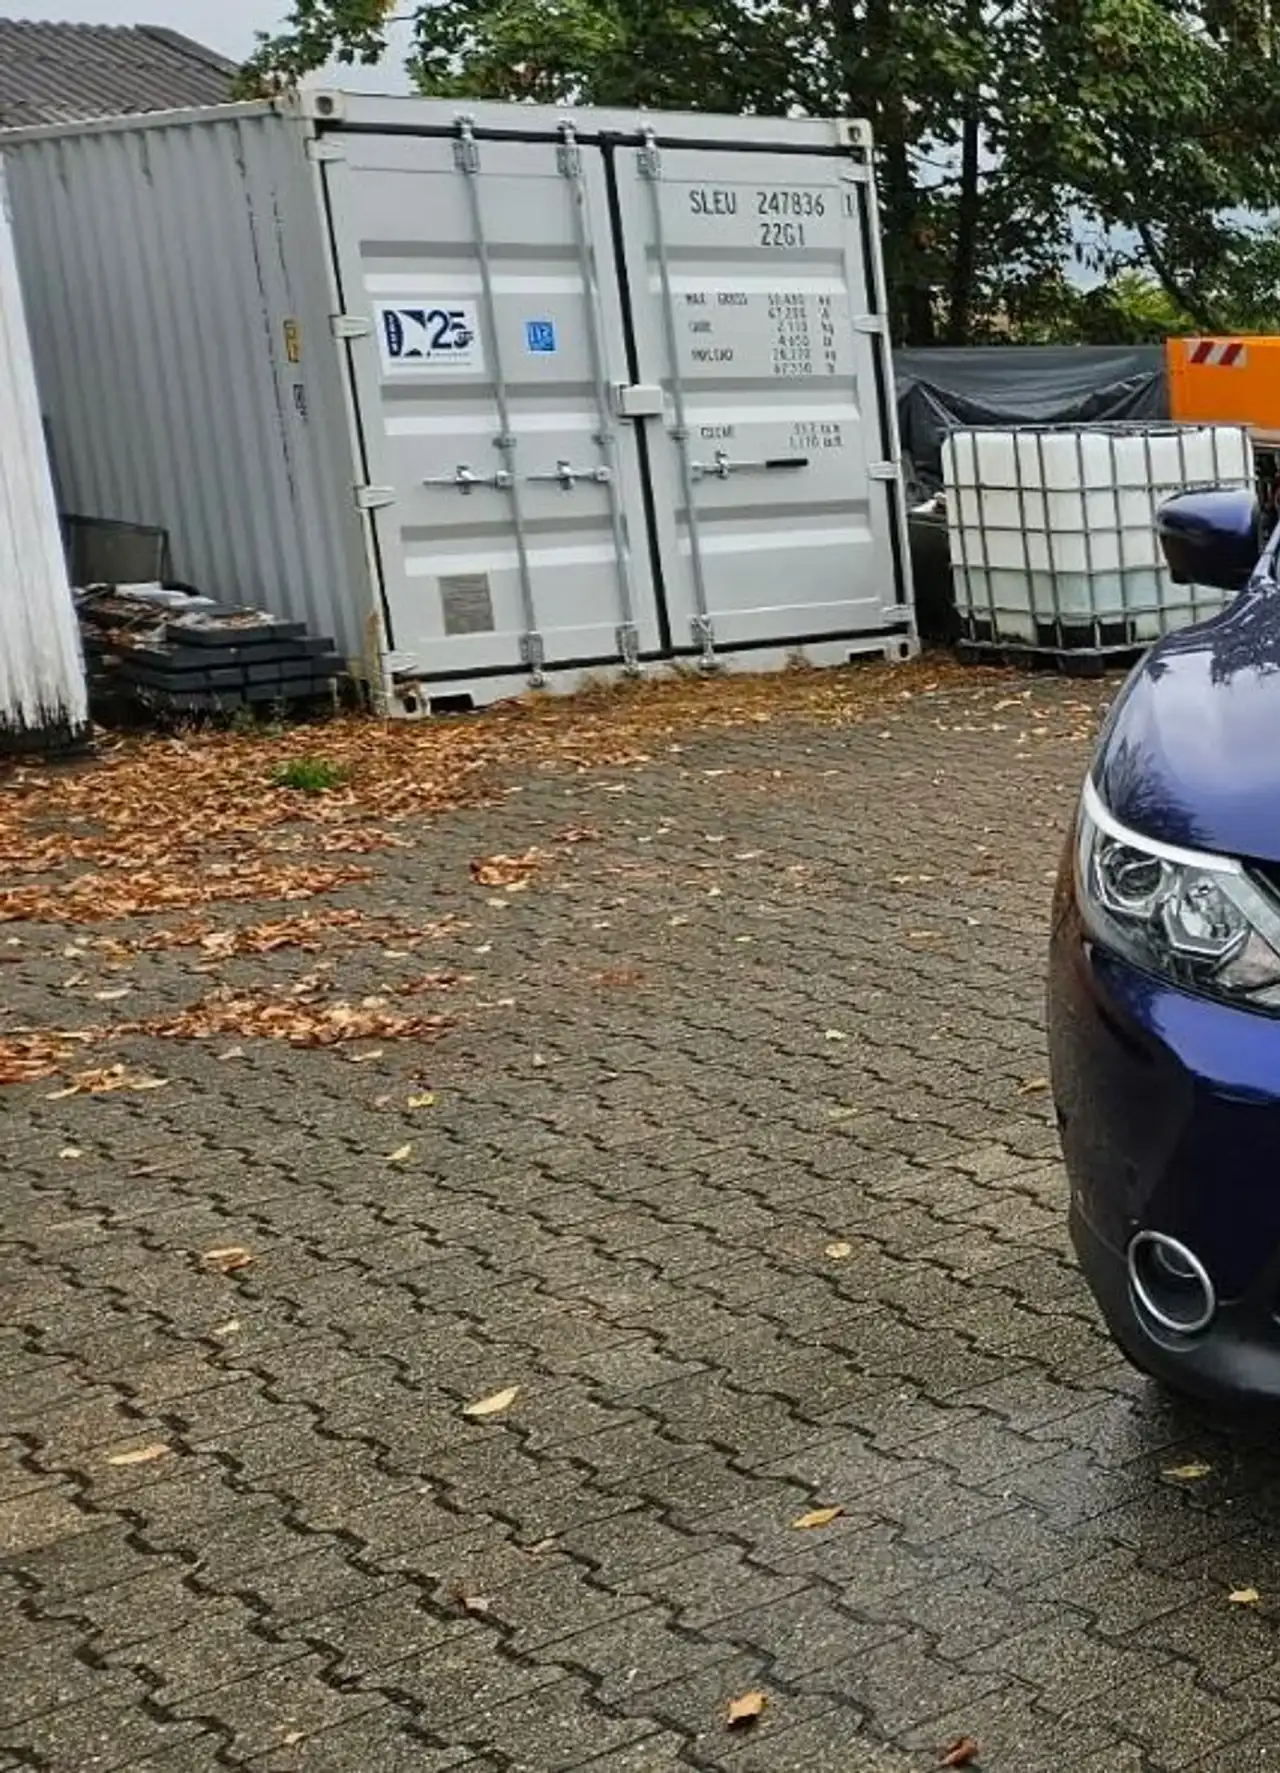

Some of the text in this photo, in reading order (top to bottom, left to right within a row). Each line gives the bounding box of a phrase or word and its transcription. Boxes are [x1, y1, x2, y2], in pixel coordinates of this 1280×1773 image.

[688, 189, 737, 215] SLEU
[756, 191, 825, 217] 247836
[760, 223, 806, 247] 22G1
